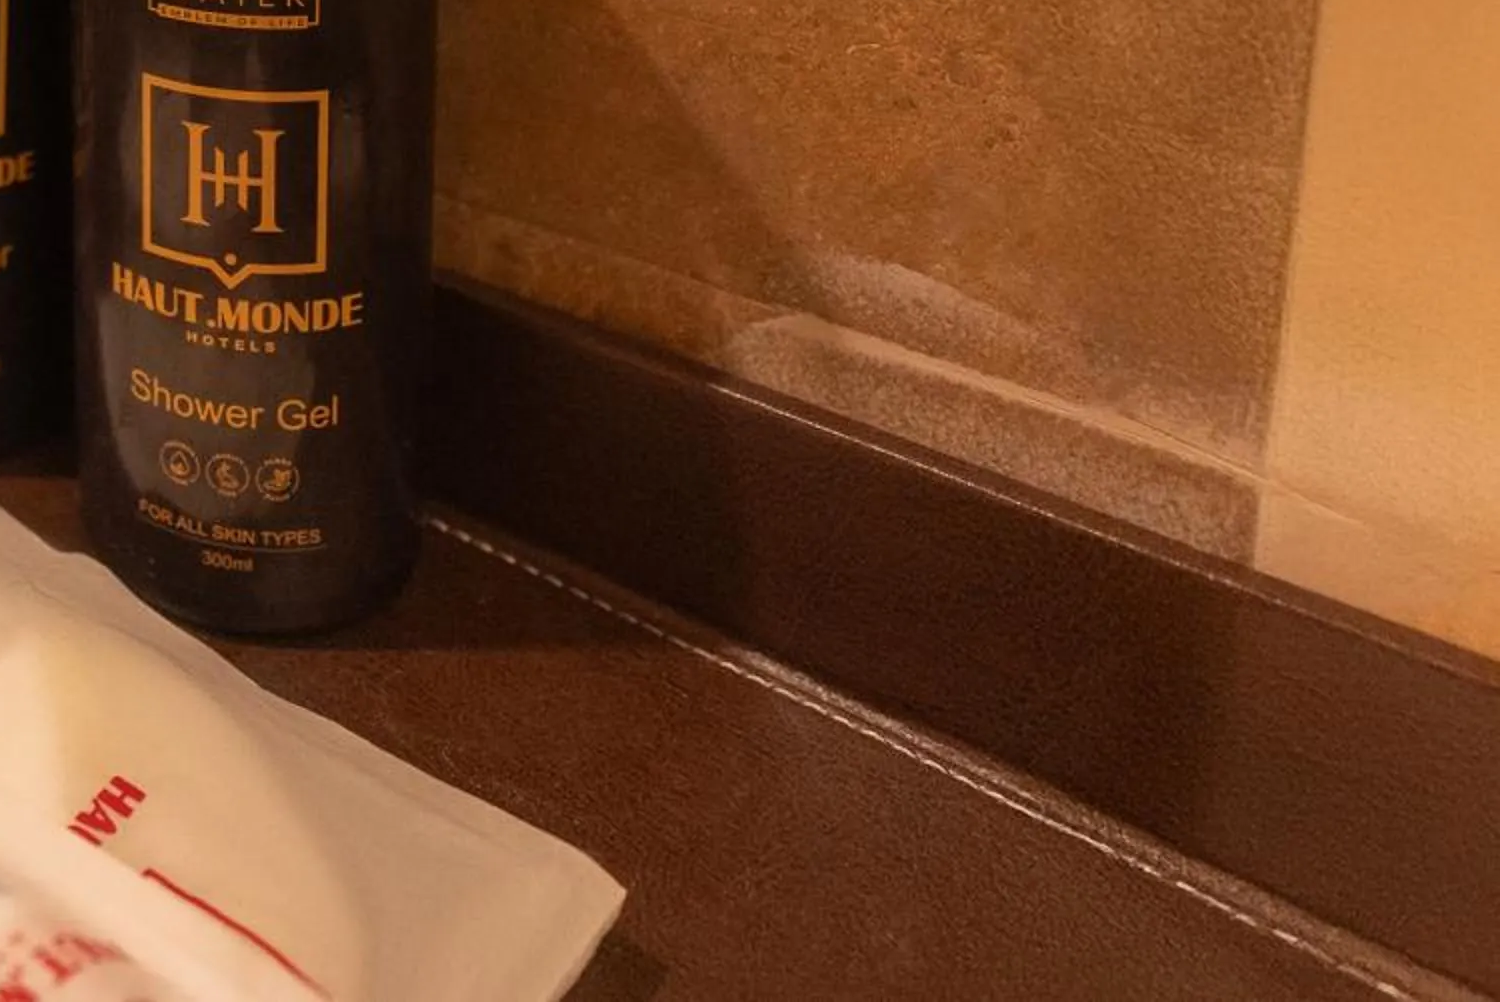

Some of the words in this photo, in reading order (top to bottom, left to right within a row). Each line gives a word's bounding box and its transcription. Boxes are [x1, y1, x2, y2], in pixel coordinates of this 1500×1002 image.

[186, 329, 277, 355] HOTELS
[130, 368, 265, 430] Shower
[276, 394, 339, 431] Gel
[138, 498, 171, 524] FOR
[175, 515, 208, 537] ALL
[211, 524, 257, 546] SKIN
[261, 528, 323, 547] TYPES
